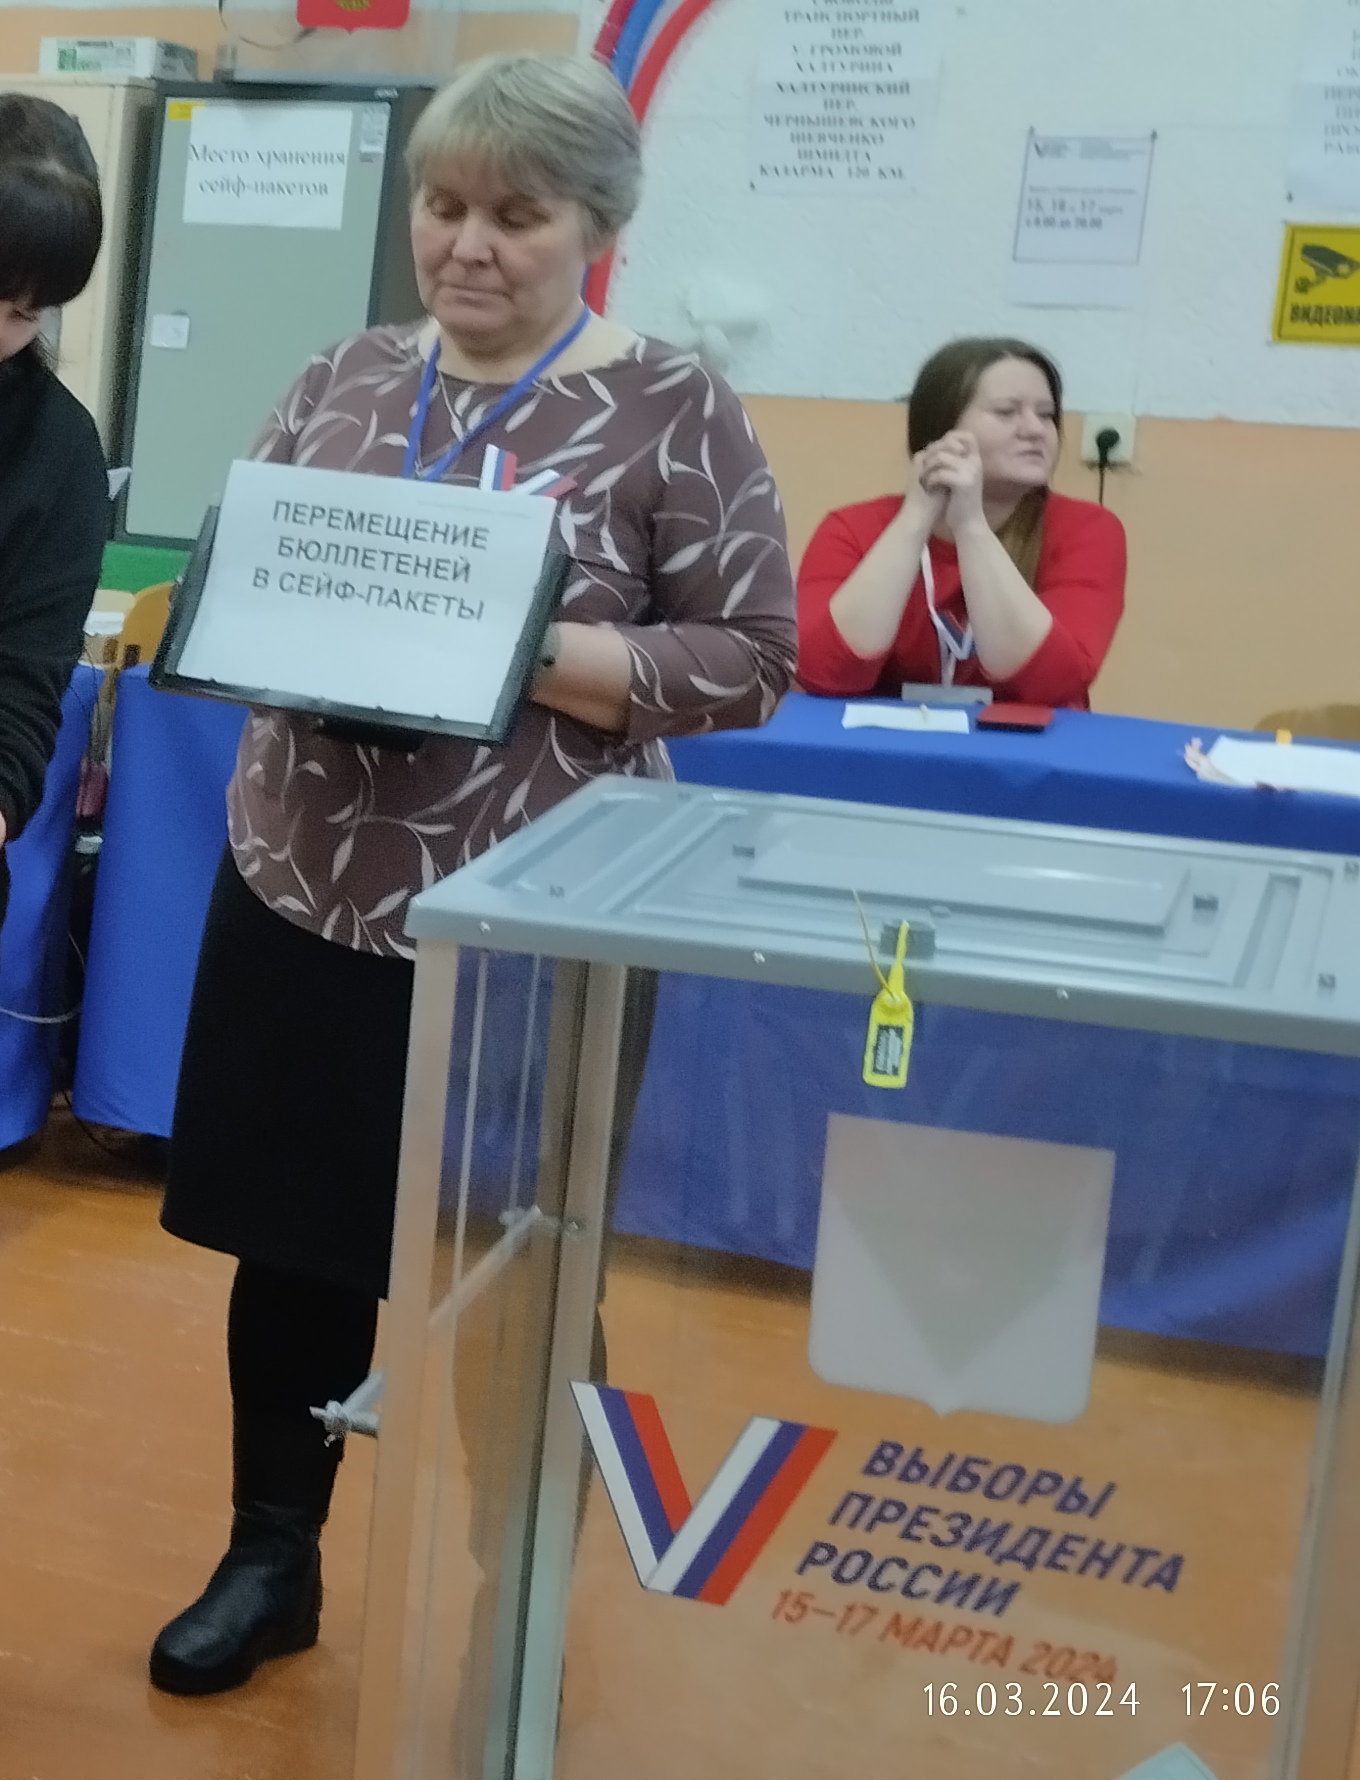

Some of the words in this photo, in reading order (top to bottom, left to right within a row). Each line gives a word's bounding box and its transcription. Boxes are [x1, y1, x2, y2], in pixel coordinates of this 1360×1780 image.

[776, 80, 910, 96] ХАЛТУРИНСКИЙ
[763, 113, 916, 130] ЧЕРНЫШЕВСКОГО
[790, 131, 885, 146] ШЕВЧЕНКО
[190, 144, 250, 164] Место
[257, 149, 346, 169] хранения
[199, 174, 329, 198] сейф-пакетов
[273, 500, 490, 551] ПЕРЕМЕЩЕНИЕ
[278, 535, 471, 584] БЮЛЛЕТЕНЕЙ
[252, 567, 270, 589] В
[279, 570, 486, 621] СЕЙФ-ПАКЕТЫ
[862, 1439, 1117, 1519] ВЫБОРЫ
[828, 1490, 1184, 1593] ПРЕЗИДЕНТА
[796, 1541, 1021, 1617] РОССИИ
[878, 1611, 1015, 1668] МАРТА
